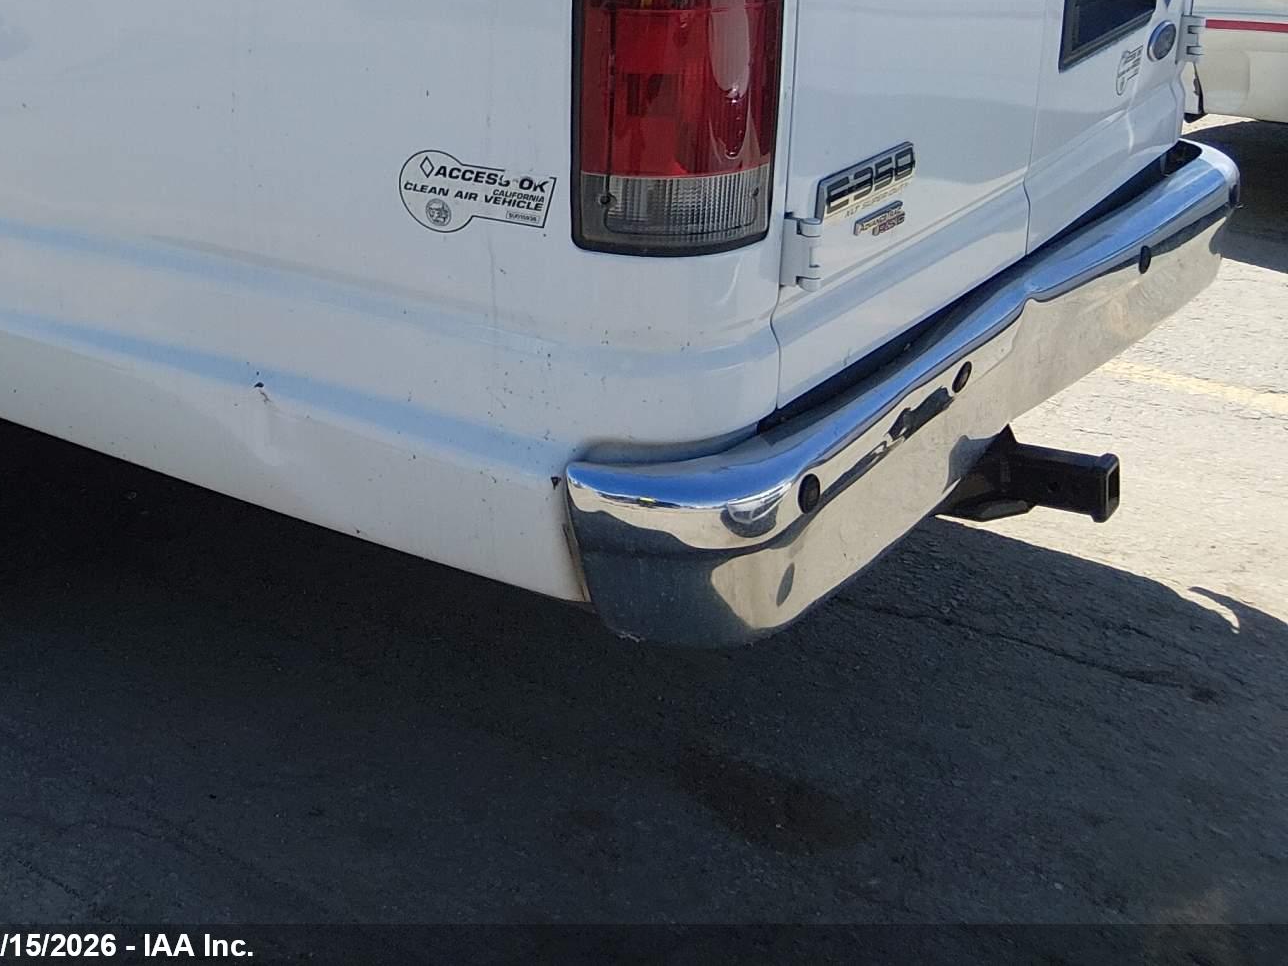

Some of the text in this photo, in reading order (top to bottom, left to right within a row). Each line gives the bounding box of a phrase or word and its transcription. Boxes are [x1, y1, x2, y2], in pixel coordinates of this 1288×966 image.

[518, 176, 550, 194] OK
[403, 181, 544, 212] CLEAN AIR VEHICLE
[492, 189, 545, 203] CALIFORNIA
